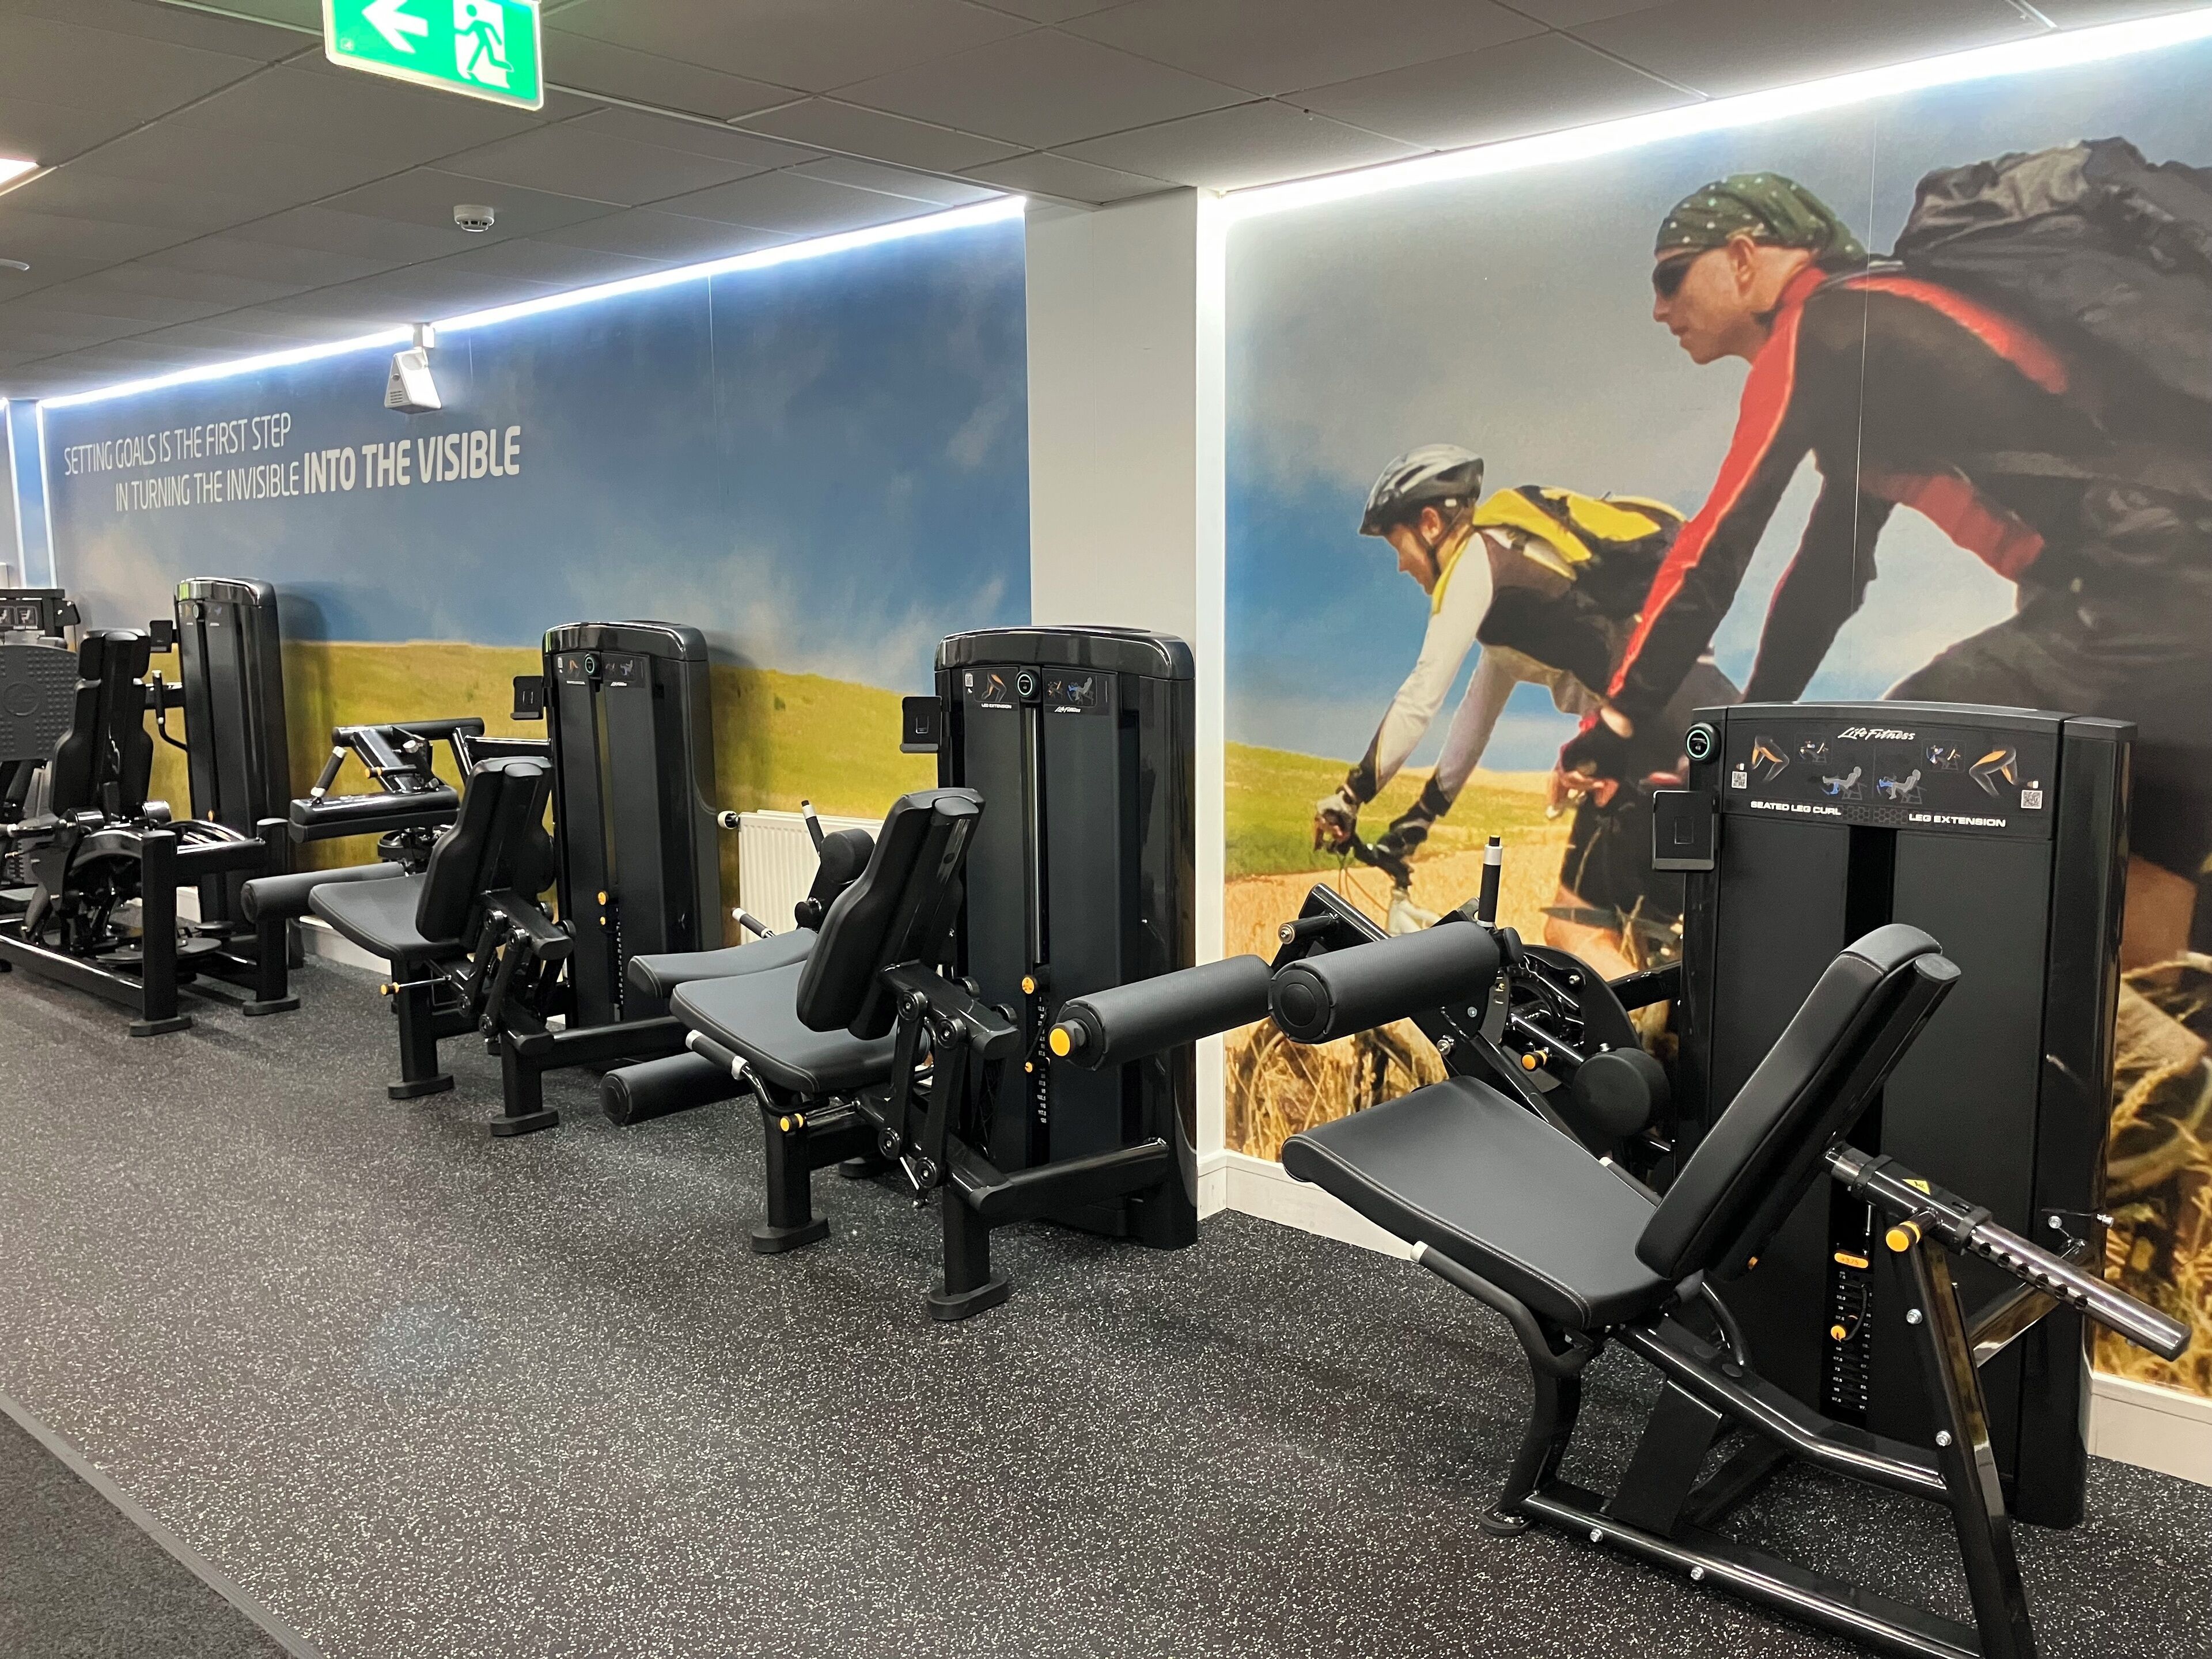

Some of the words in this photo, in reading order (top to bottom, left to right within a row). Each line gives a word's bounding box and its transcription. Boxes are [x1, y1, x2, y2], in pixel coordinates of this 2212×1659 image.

[64, 441, 112, 475] SETTING
[115, 434, 156, 469] GOALS
[159, 431, 171, 463] IS
[174, 426, 202, 460] THE
[206, 419, 248, 456] FIRST
[252, 412, 291, 450] STEP
[116, 482, 128, 512] IN
[131, 474, 190, 510] TURNING
[194, 470, 222, 504] THE
[227, 461, 299, 502] INVISIBLE
[304, 447, 356, 494] INTO
[362, 440, 411, 488] THE
[418, 425, 521, 483] VISIBLE
[1838, 727, 1866, 739] Life
[1864, 728, 1916, 741] Fitness
[1750, 801, 1790, 812] SEATED
[1791, 804, 1812, 813] LEG
[1813, 806, 1842, 815] CURL
[1908, 813, 1931, 823] LEG
[1933, 815, 2006, 827] EXTENSION
